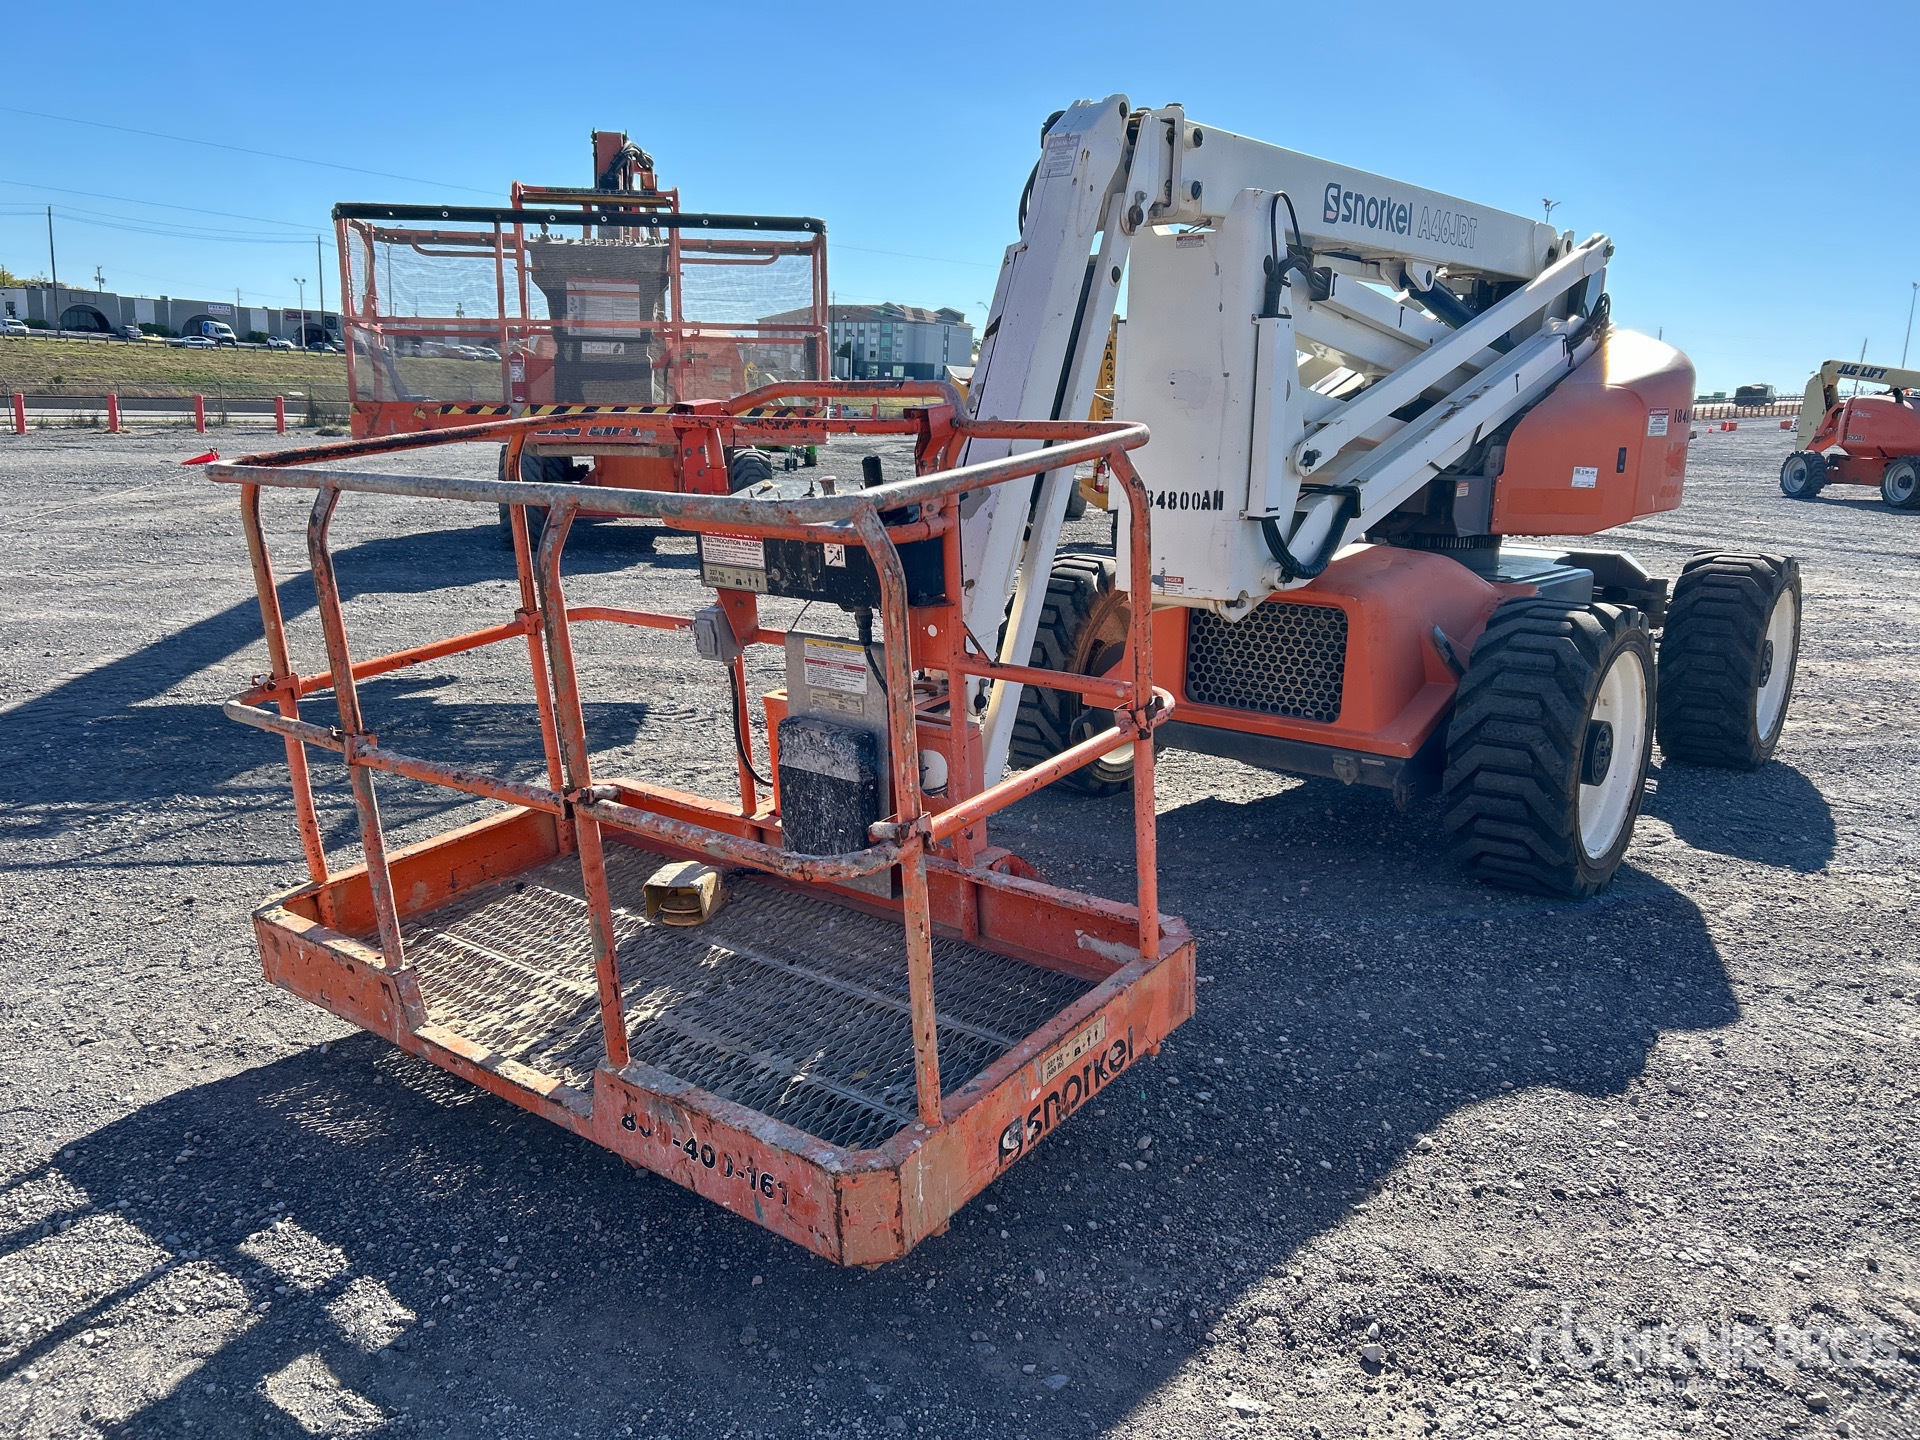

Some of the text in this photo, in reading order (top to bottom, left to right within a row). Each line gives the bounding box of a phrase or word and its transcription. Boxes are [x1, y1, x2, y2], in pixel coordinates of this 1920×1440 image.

[1342, 191, 1413, 236] snorkel
[1418, 206, 1477, 249] A46JRT
[1837, 364, 1887, 379] JLG LIFT
[702, 536, 741, 546] ELECTROCUTION
[741, 540, 763, 549] HAZARD
[1047, 1058, 1056, 1070] 227
[1027, 1025, 1134, 1146] snorkel
